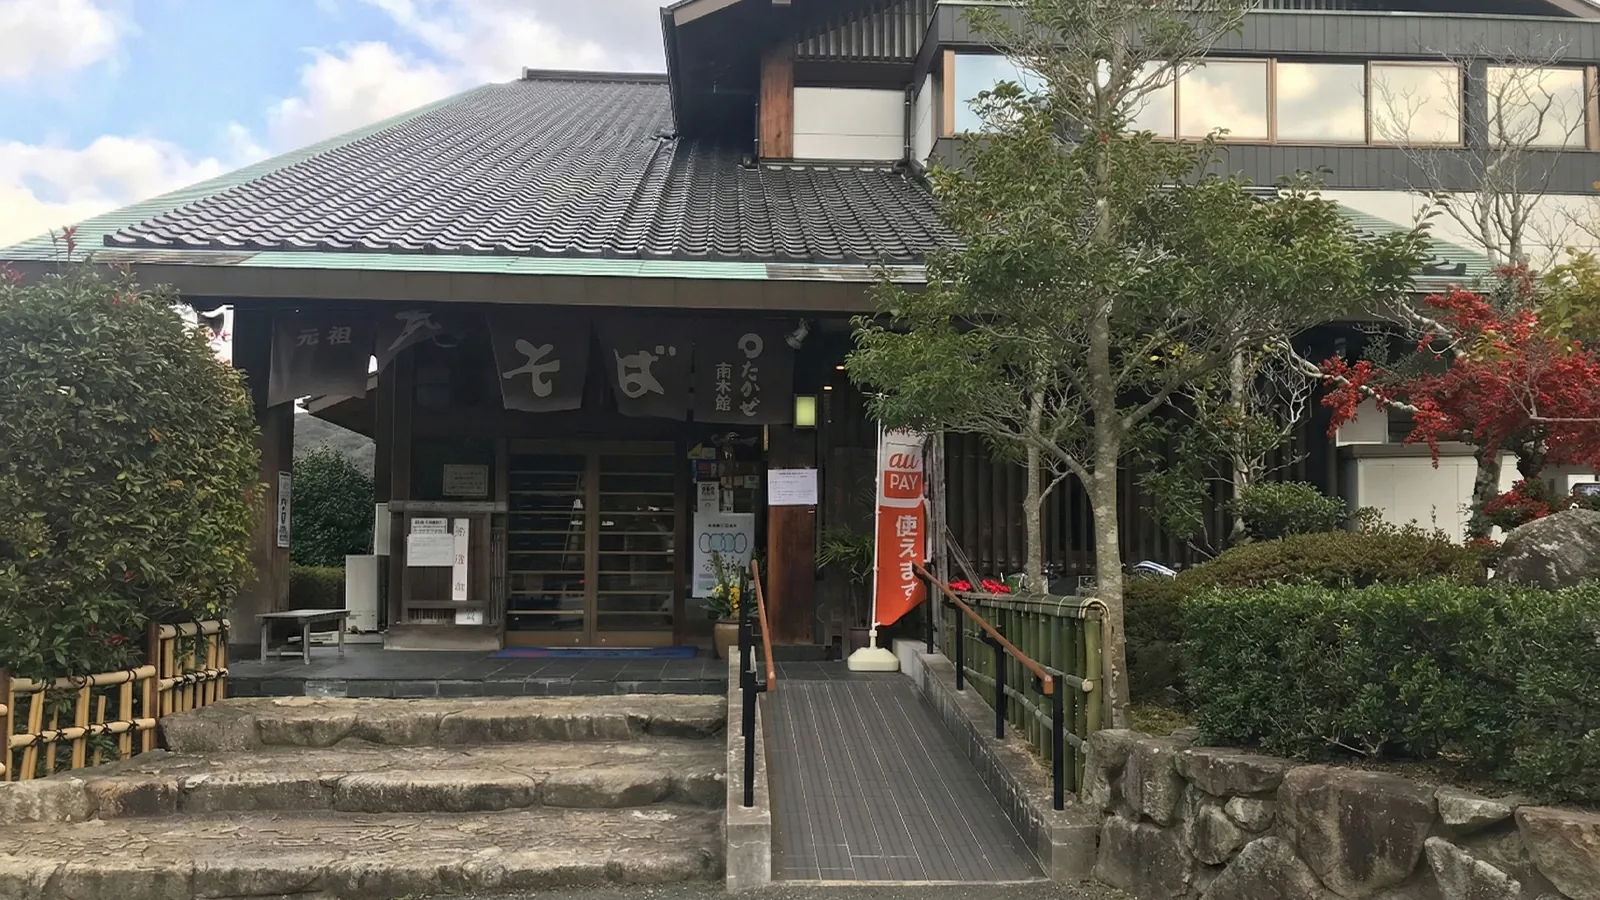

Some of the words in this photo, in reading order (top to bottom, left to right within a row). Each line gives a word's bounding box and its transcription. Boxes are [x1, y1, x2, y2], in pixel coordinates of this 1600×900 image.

[294, 325, 352, 348] 元祖
[888, 453, 920, 469] au
[889, 473, 918, 490] PAY
[895, 514, 919, 601] 使えます
